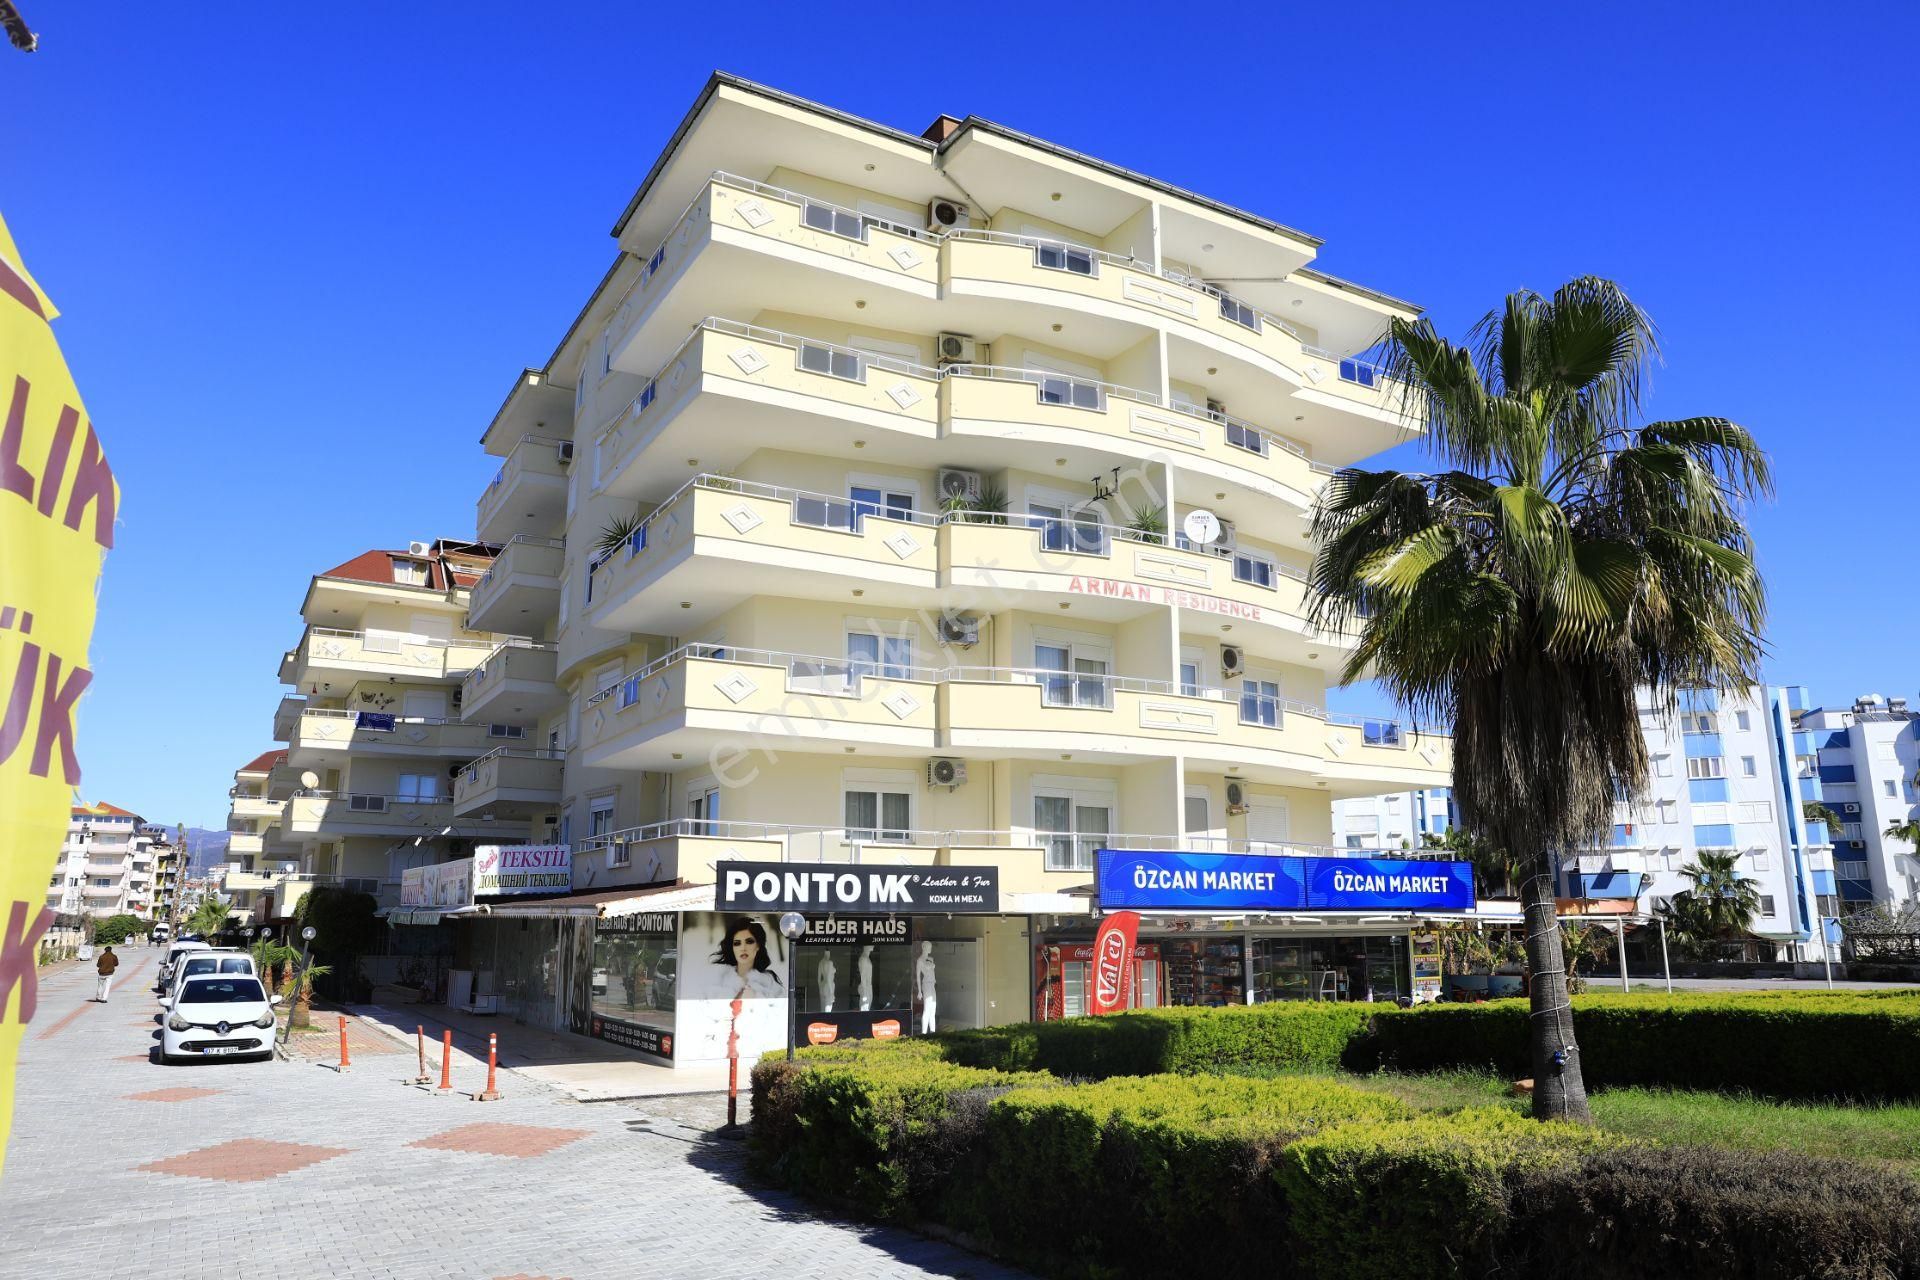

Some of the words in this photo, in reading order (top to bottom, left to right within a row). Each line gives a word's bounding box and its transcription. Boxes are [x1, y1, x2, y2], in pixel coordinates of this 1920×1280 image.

[1068, 575, 1151, 602] ARMAN
[1163, 587, 1262, 621] RESIDENCE
[500, 846, 569, 868] TEKSTİL
[478, 872, 529, 889] ДОМАШНИЙ
[529, 872, 569, 888] ТЕКСТИЛЬ
[725, 870, 862, 903] PONTO
[921, 875, 957, 887] Leather
[961, 876, 969, 887] &
[973, 876, 991, 888] Fur
[1133, 865, 1198, 890] ÖZCAN
[1202, 870, 1275, 891] MARKET
[1333, 870, 1386, 892] ÖZCAN
[1389, 875, 1449, 893] MARKET
[929, 895, 953, 903] КОЖА
[954, 895, 960, 903] И
[961, 895, 984, 903] МЕХА
[805, 920, 858, 935] LEDER
[862, 920, 907, 935] HAUS
